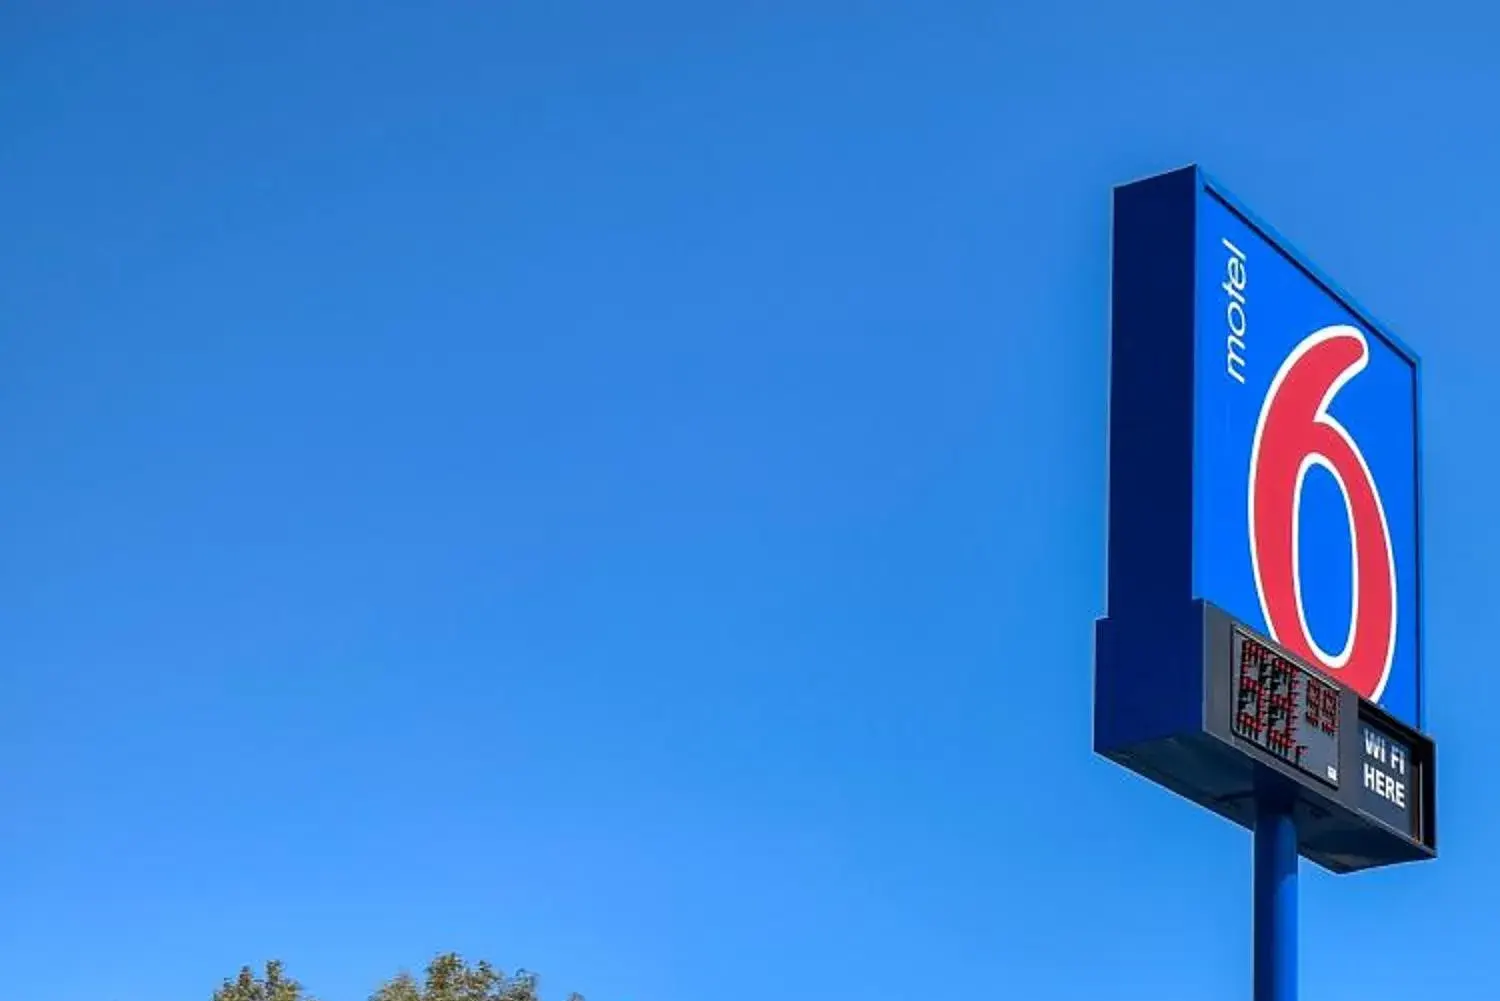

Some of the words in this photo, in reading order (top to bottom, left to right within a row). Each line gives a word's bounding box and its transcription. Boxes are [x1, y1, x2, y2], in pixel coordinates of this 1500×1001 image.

[1221, 236, 1247, 385] motel
[1248, 325, 1397, 704] 6
[1363, 763, 1405, 809] HERE
